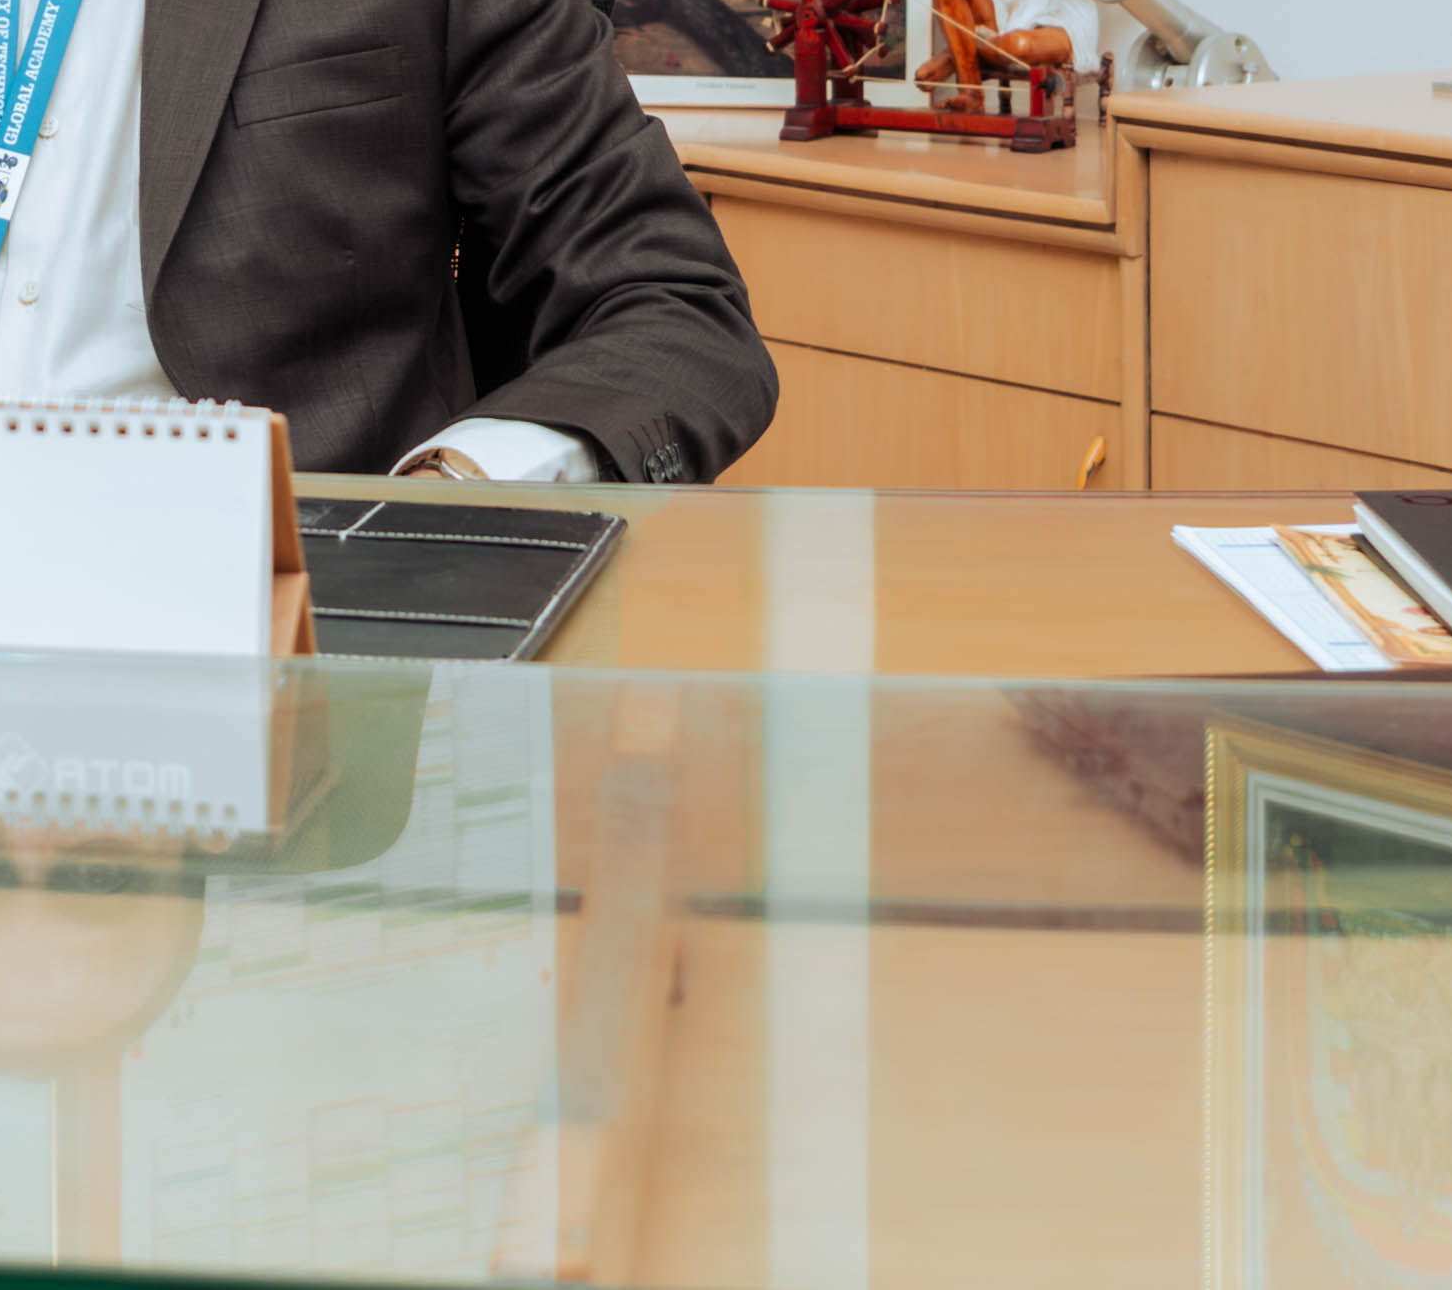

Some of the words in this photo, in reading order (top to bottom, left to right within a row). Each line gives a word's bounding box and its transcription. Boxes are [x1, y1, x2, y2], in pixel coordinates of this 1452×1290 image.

[3, 83, 35, 146] GLOBAL
[26, 0, 60, 80] ACADEMY
[55, 756, 193, 795] ATOM
